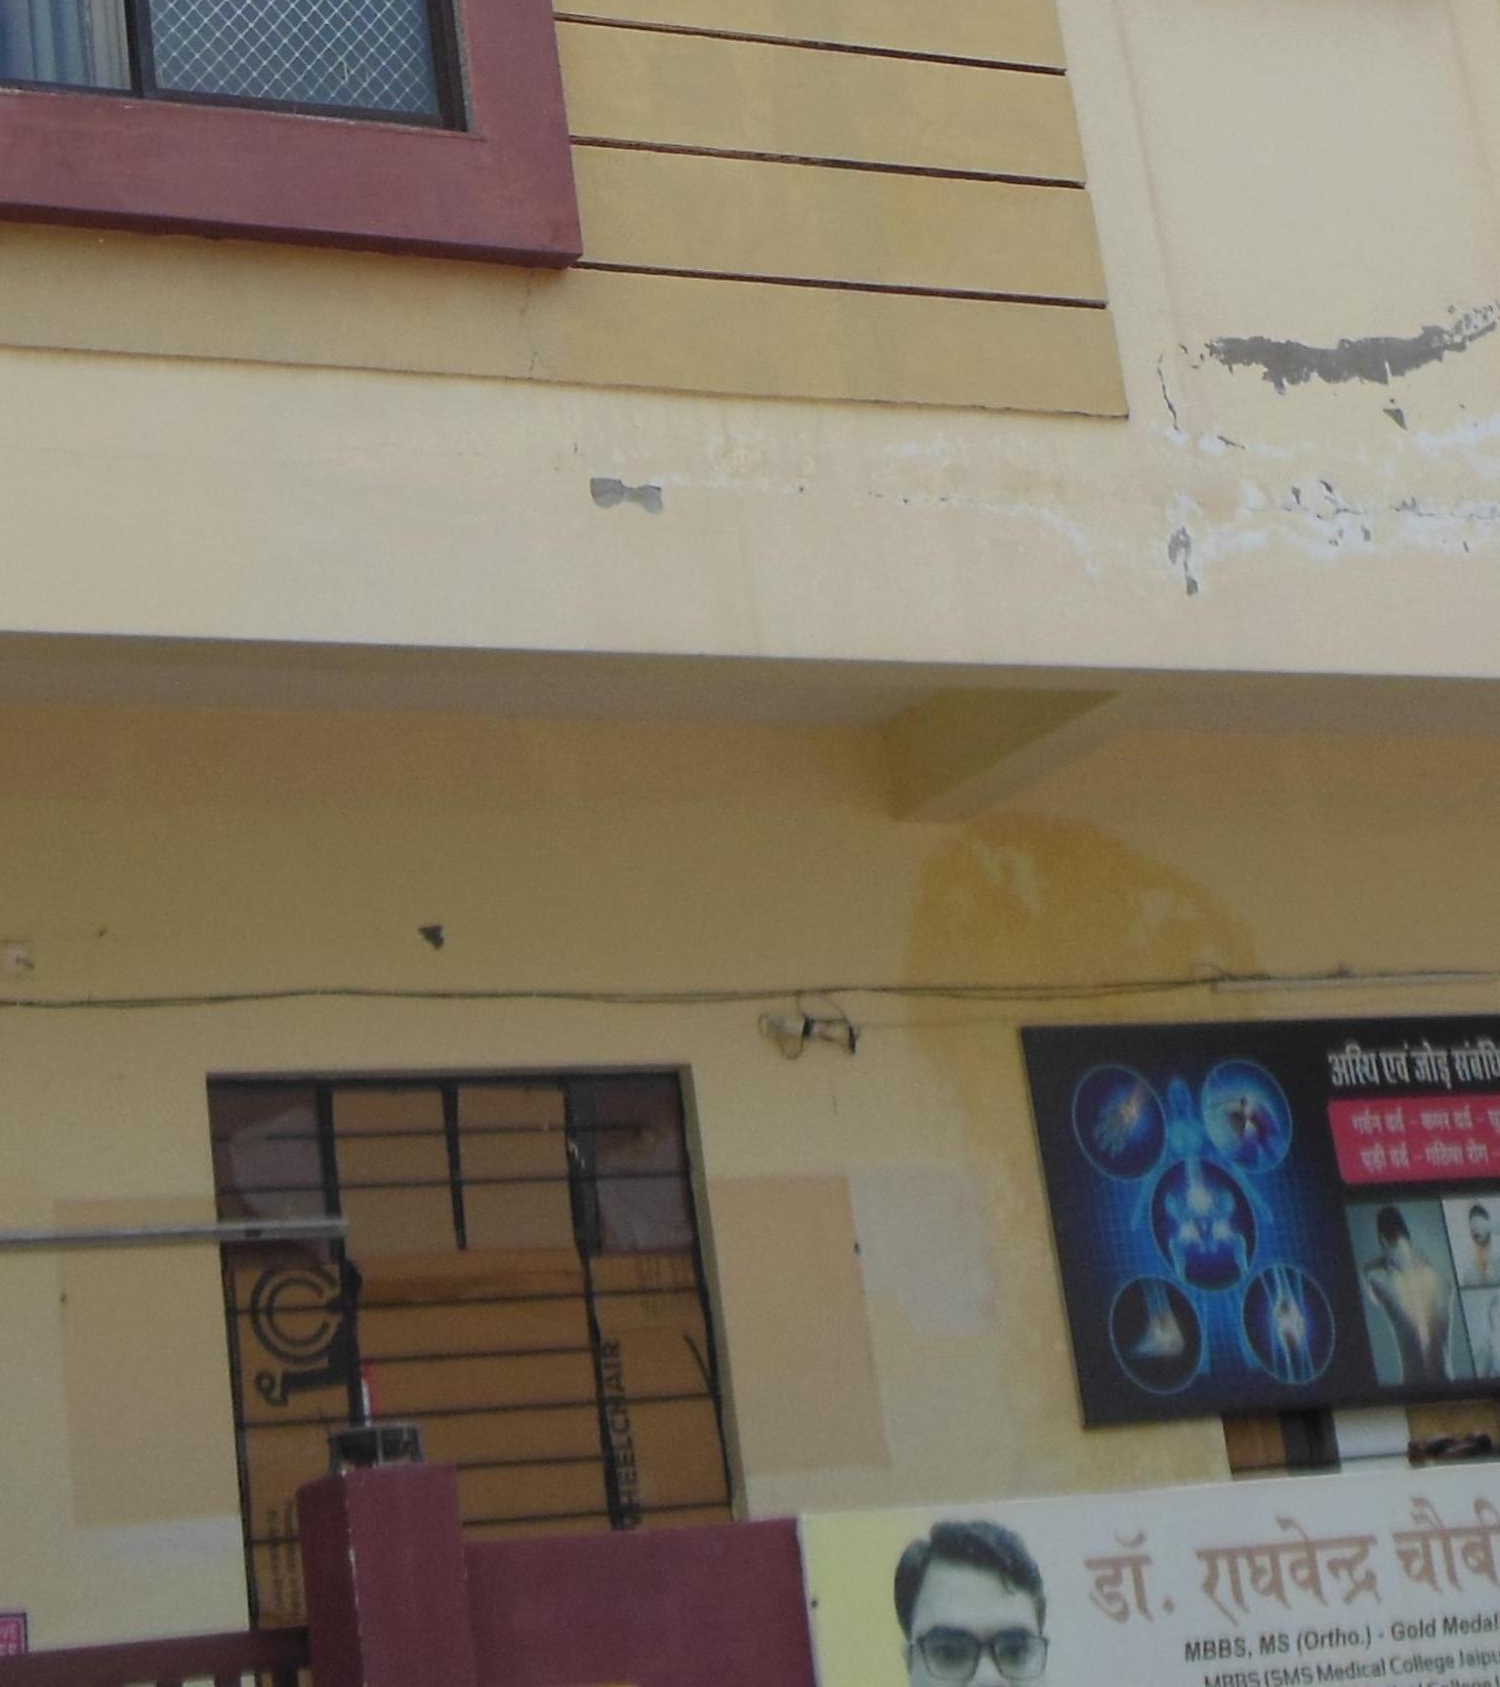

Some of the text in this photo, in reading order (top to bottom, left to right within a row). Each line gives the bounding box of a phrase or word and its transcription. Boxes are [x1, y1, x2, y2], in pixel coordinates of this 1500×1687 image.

[1083, 1529, 1177, 1624] डॉ.
[1195, 1515, 1382, 1627] राघवेन्द्र
[1185, 1638, 1252, 1663] MBBS,
[1259, 1633, 1290, 1656] MS
[1297, 1623, 1372, 1657] (Ortho.)
[1390, 1618, 1437, 1643] Gold
[1318, 1657, 1386, 1682] Medical
[1390, 1654, 1455, 1674] College
